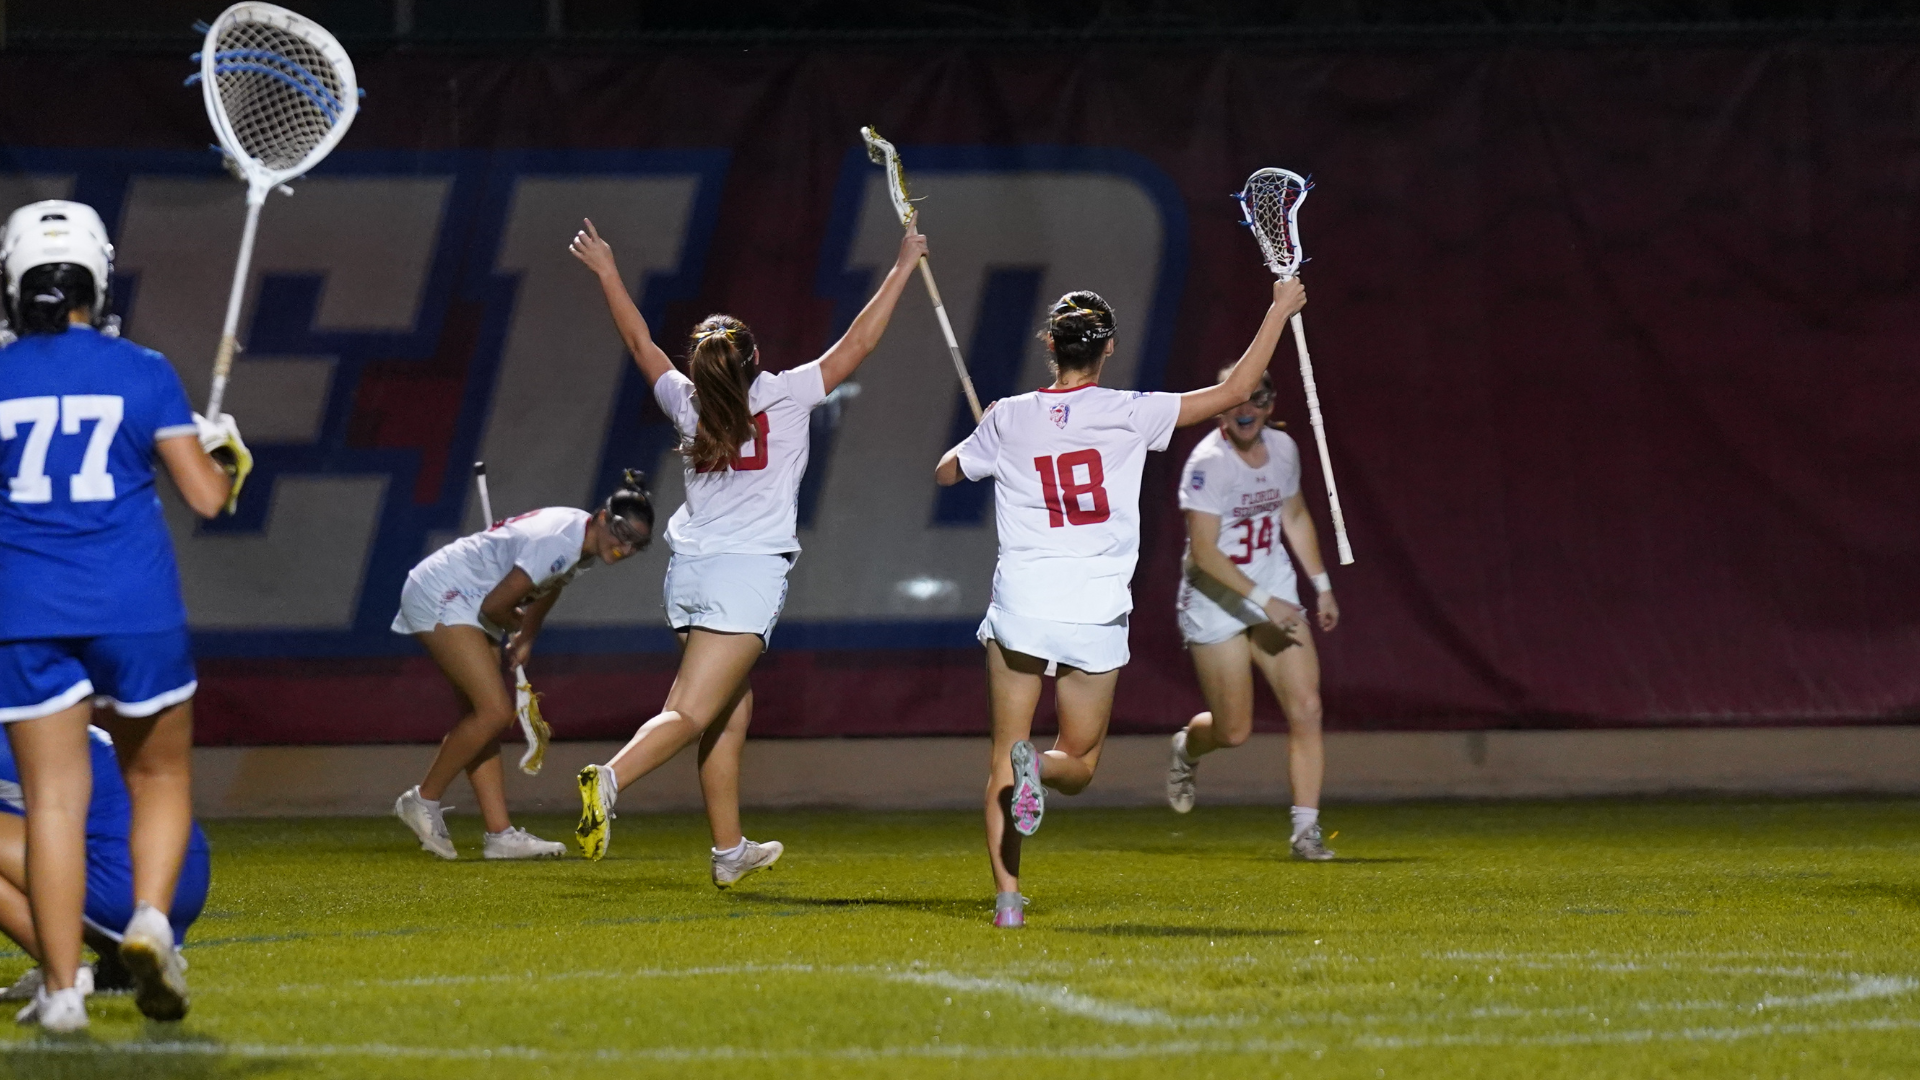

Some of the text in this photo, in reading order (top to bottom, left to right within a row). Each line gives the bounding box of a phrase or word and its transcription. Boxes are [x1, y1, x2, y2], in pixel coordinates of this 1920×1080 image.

[0, 165, 1175, 636] ELD
[0, 394, 124, 504] 77
[1034, 448, 1111, 528] 18
[1230, 516, 1273, 565] 34
